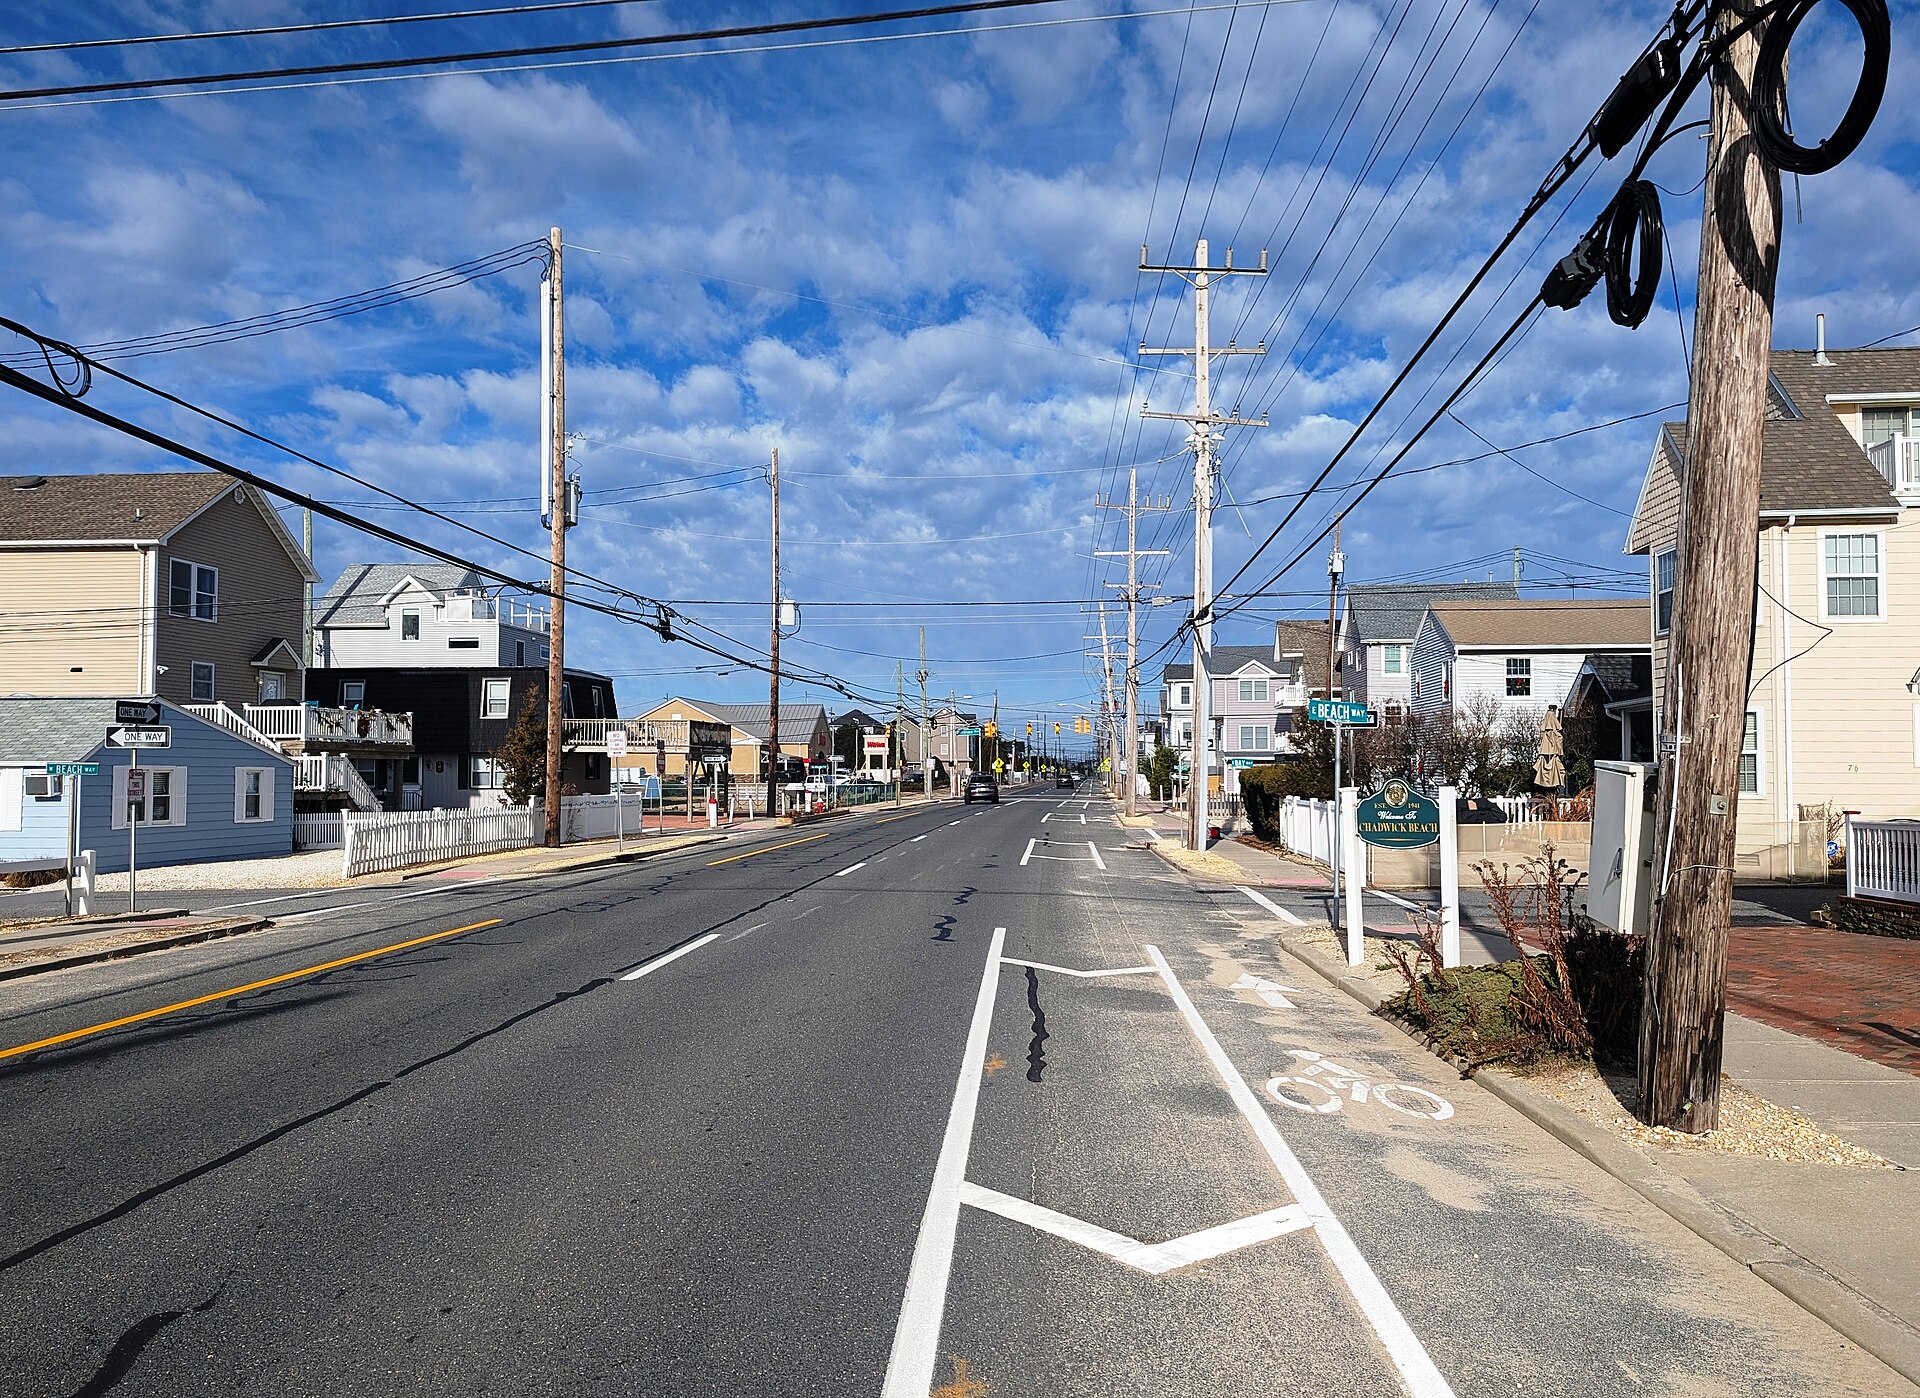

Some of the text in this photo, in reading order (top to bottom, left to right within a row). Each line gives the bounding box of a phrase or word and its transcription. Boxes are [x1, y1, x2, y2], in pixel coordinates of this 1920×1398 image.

[120, 707, 147, 718] ONE WAY
[1312, 703, 1365, 719] E BEACH WAY
[124, 733, 163, 741] ONE WAY
[1235, 759, 1246, 767] BAY
[55, 765, 83, 774] BEACH
[1377, 810, 1418, 820] Welcome To
[1359, 822, 1438, 833] CHADWICK BEACH
